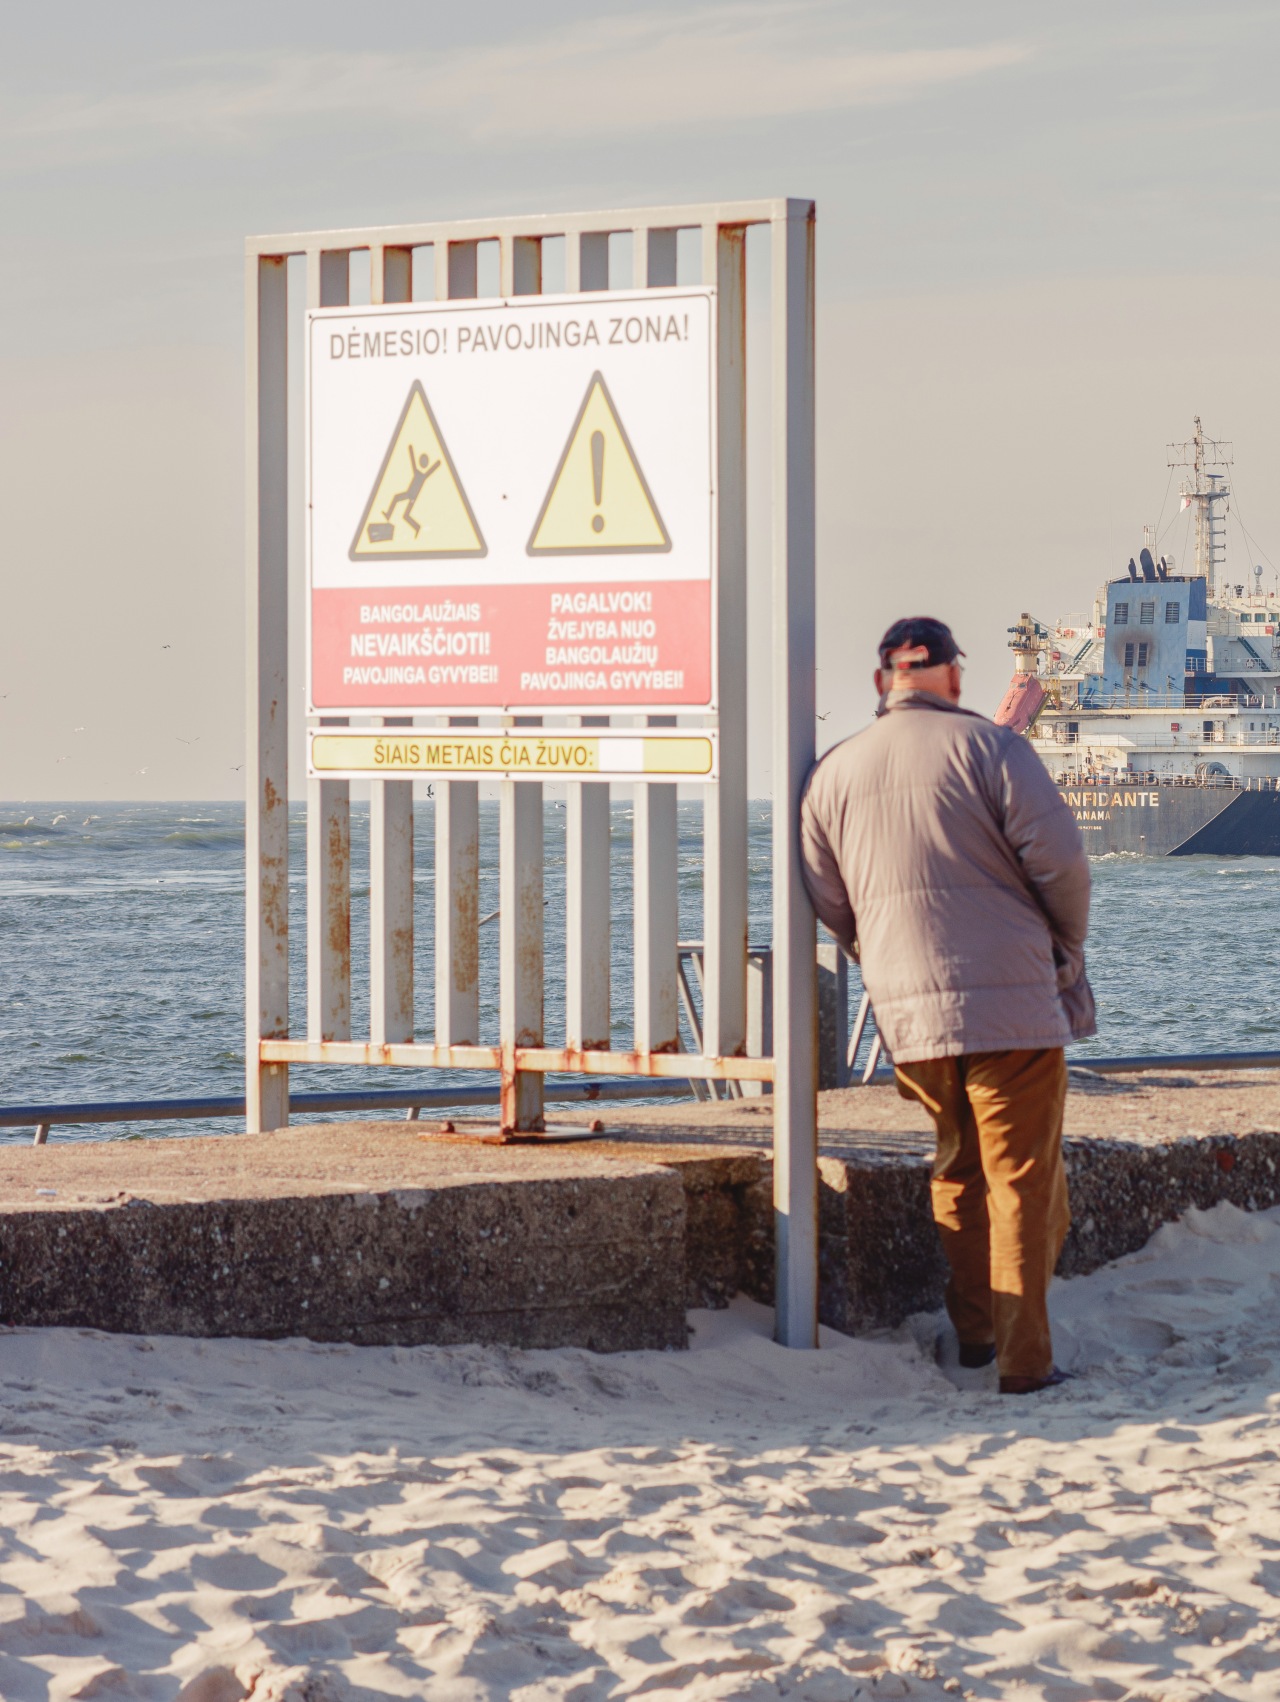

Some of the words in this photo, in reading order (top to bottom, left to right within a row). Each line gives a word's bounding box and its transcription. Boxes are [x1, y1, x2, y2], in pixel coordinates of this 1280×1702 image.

[330, 326, 448, 360] DĖMESIO!
[457, 320, 600, 353] PAVOJINGA
[608, 314, 690, 344] ZONA!
[360, 600, 481, 624] BANGOLAUŽIAIS
[550, 591, 652, 613] PAGALVOK!
[547, 617, 618, 640] ŽVEJYBA
[620, 619, 655, 639] NUO
[350, 627, 490, 657] NEVAIKŠČIOTI!
[545, 644, 658, 669] BANGOLAUŽIŲ
[343, 667, 426, 685] PAVOJINGA
[429, 666, 498, 684] GYVYBEI!
[520, 672, 607, 691] PAVOJINGA
[610, 671, 684, 690] GYVYBEI!
[373, 739, 420, 764] ŠIAIS
[426, 745, 493, 765] METAIS
[500, 740, 531, 765] ČIA
[536, 741, 594, 766] ŽUVO:
[1072, 810, 1111, 821] ANAMA
